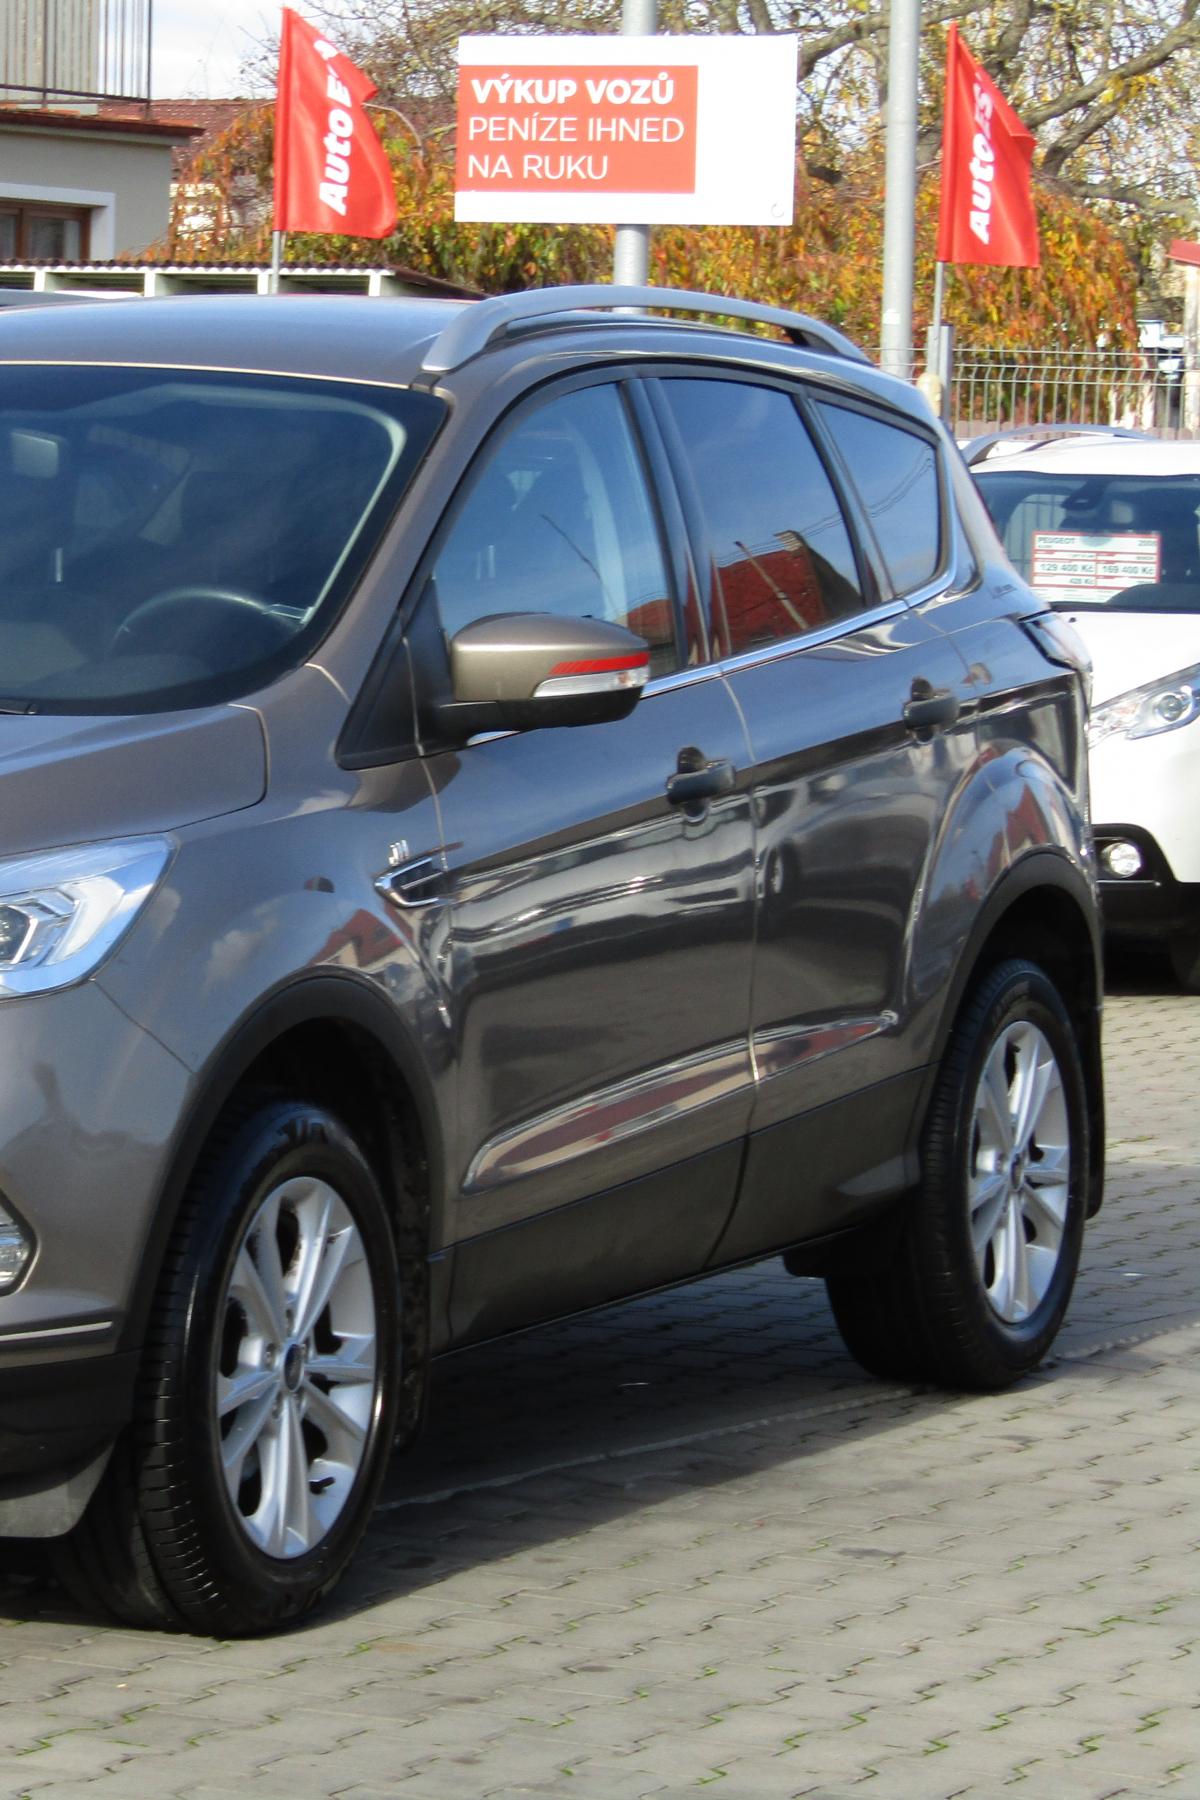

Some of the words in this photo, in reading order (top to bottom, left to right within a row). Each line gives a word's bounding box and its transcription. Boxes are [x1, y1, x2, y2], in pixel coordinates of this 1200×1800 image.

[471, 73, 577, 104] VÝKUP
[585, 72, 675, 104] VOZŮ
[468, 113, 578, 142] PENÍZE
[588, 117, 684, 143] IHNED
[318, 108, 354, 217] Auto
[467, 154, 513, 179] NA
[523, 155, 608, 180] RUKU
[969, 132, 995, 245] Auto
